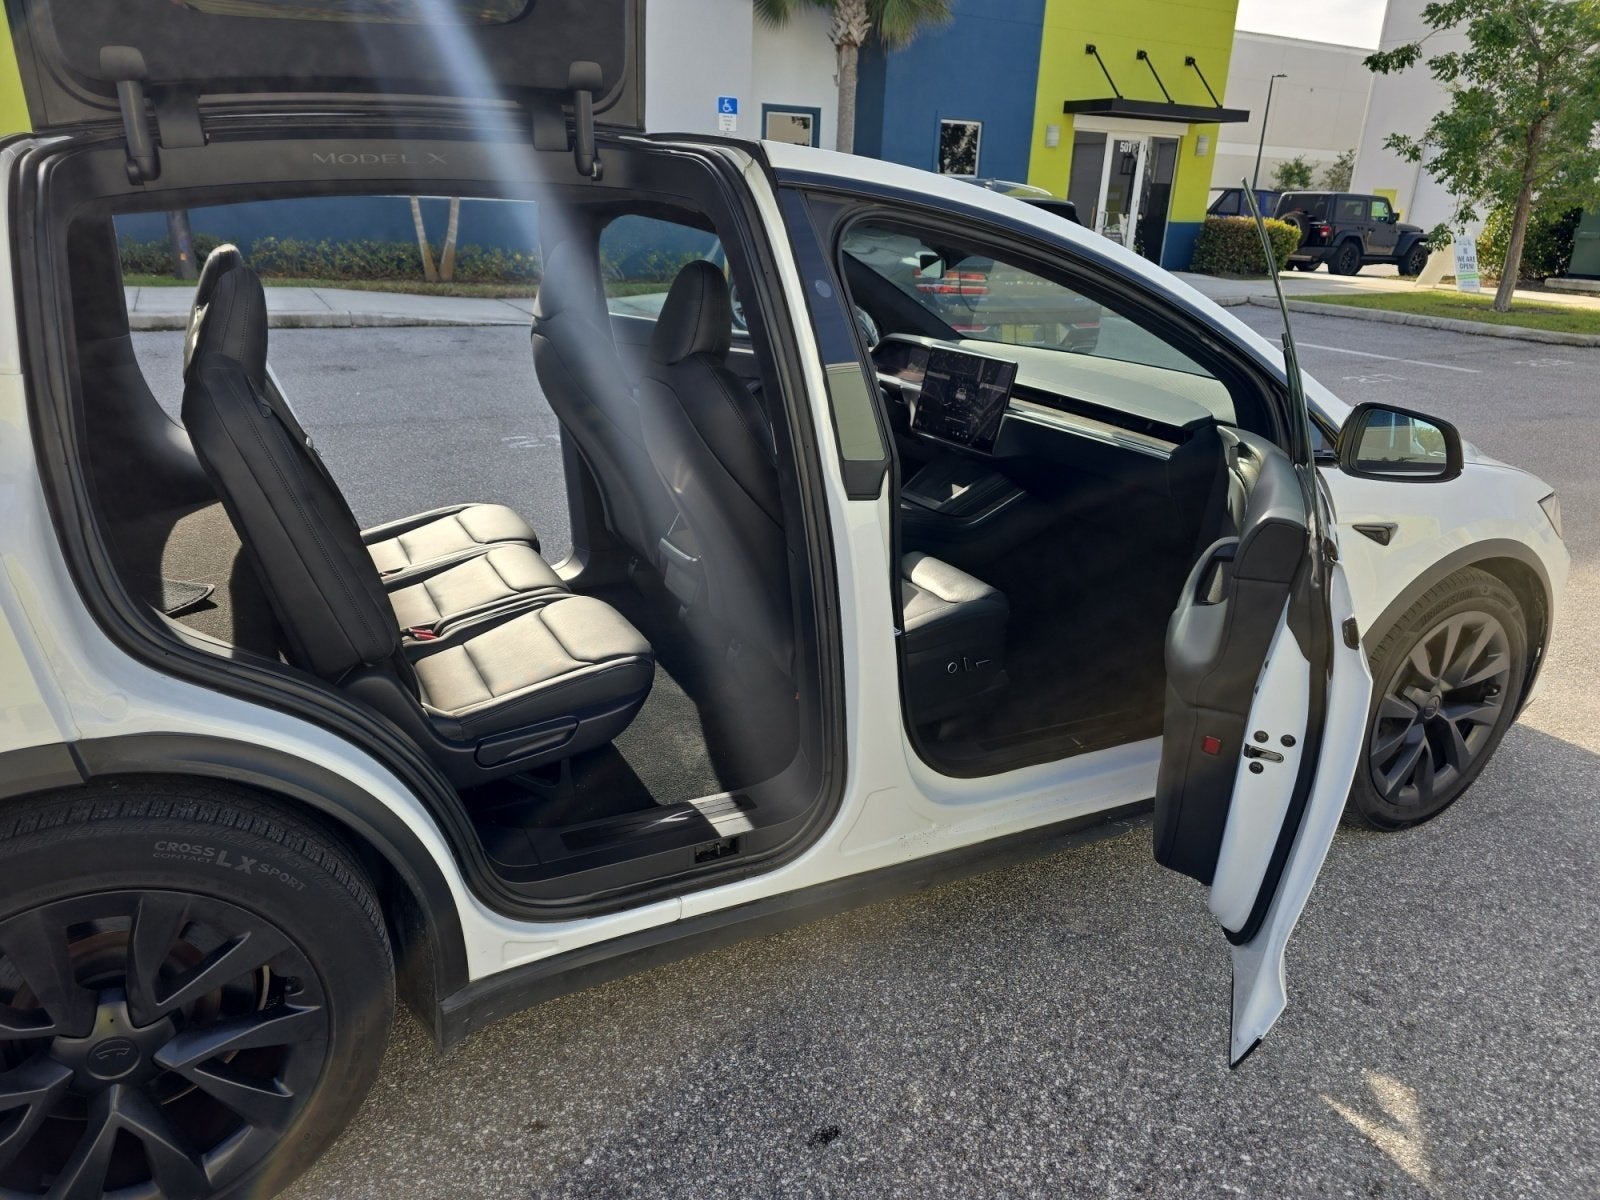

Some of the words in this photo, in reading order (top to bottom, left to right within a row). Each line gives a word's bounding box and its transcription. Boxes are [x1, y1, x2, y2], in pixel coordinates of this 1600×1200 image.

[312, 152, 418, 165] MODEL
[427, 152, 448, 165] X
[154, 841, 215, 857] CROSS
[152, 852, 213, 863] CONTACT
[258, 863, 307, 891] SPORT
